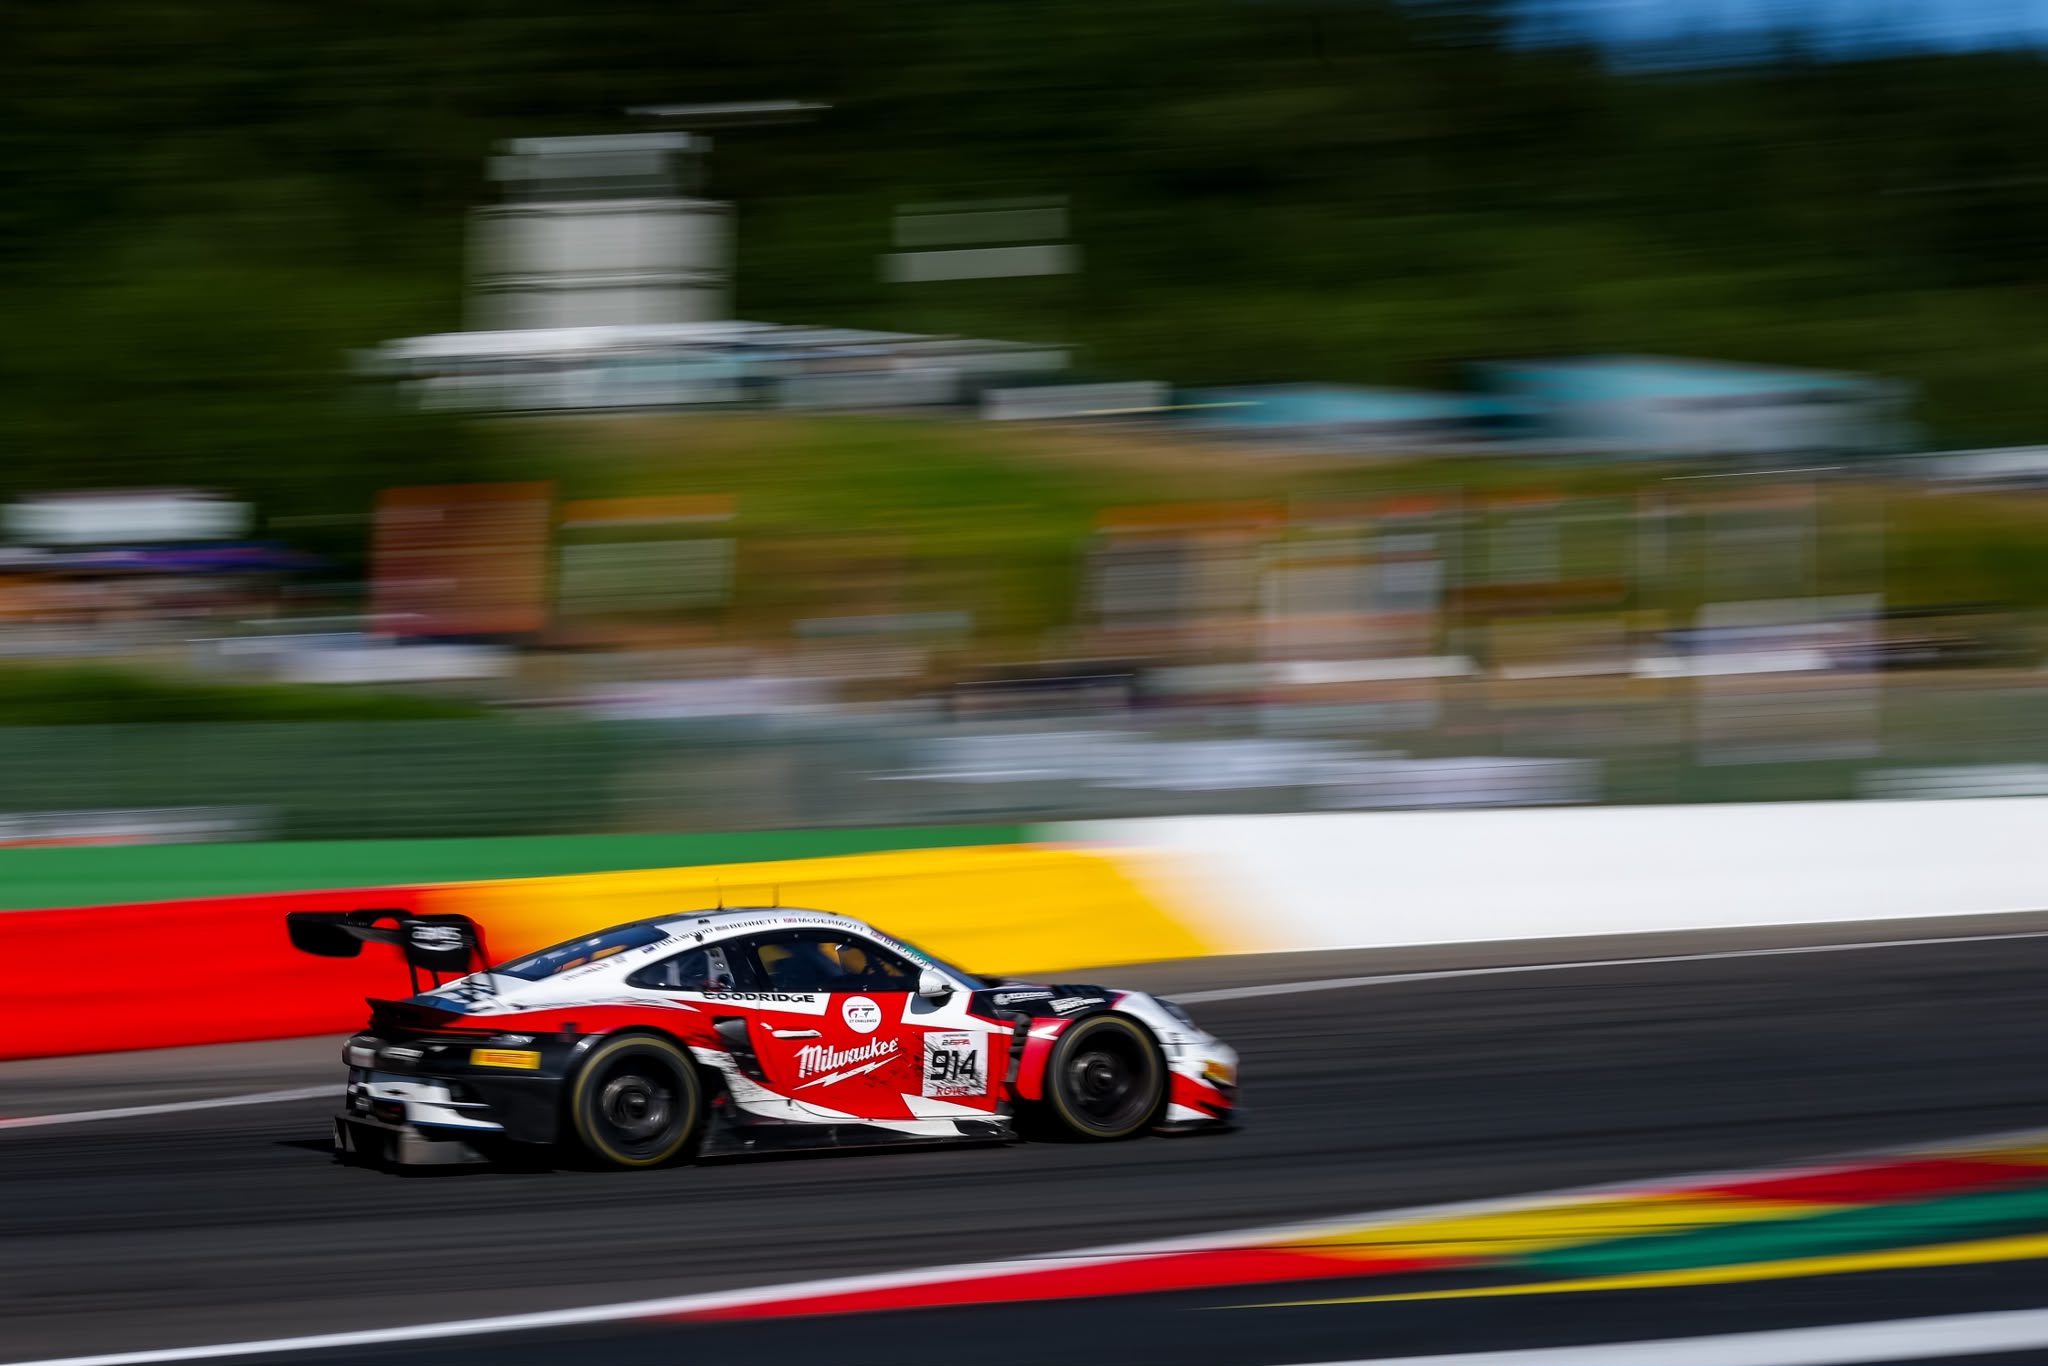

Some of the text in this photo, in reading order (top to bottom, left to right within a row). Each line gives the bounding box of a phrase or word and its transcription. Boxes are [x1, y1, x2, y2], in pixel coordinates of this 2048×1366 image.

[729, 918, 778, 929] BENNETT
[793, 1036, 899, 1079] Milwaukee
[930, 1049, 977, 1081] 914
